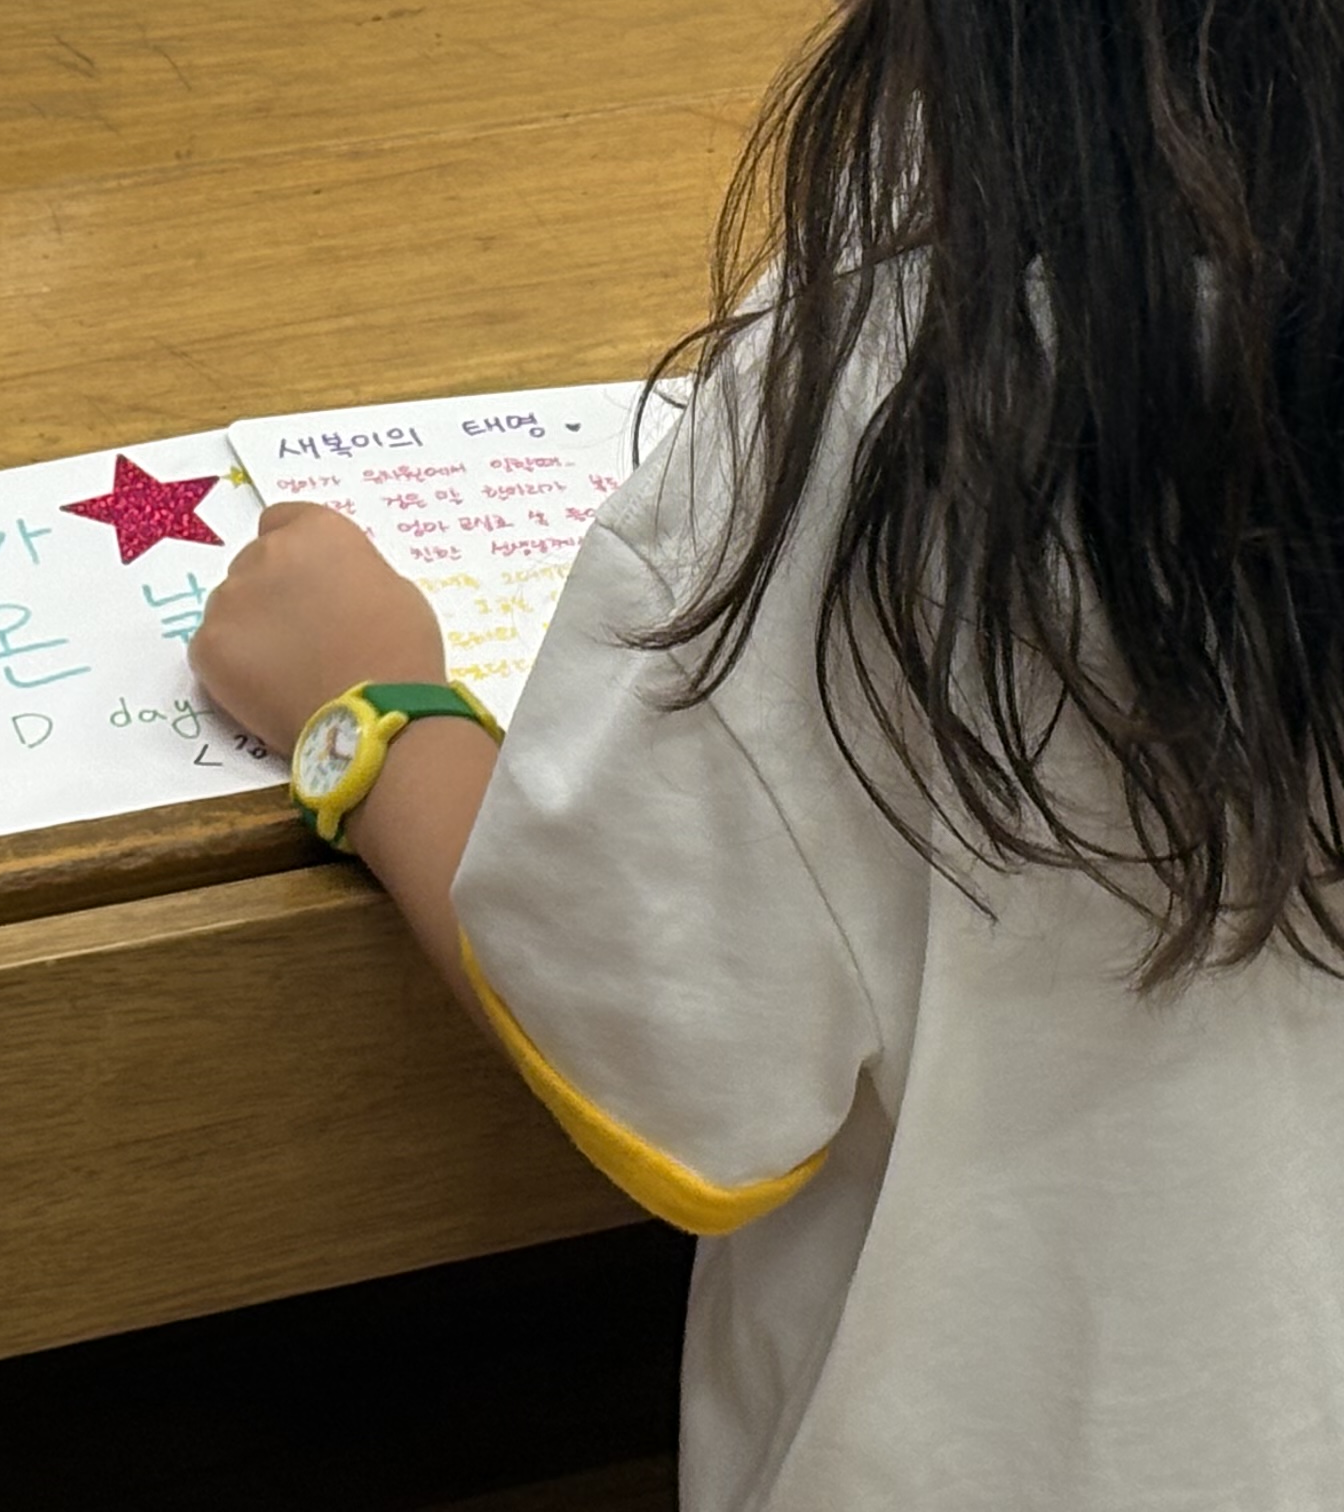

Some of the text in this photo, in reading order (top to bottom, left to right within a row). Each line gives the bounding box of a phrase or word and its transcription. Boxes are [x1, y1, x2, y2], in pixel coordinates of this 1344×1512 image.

[277, 411, 547, 460] 새복이의 태명
[396, 519, 451, 538] 엄마
[10, 694, 217, 749] D day
